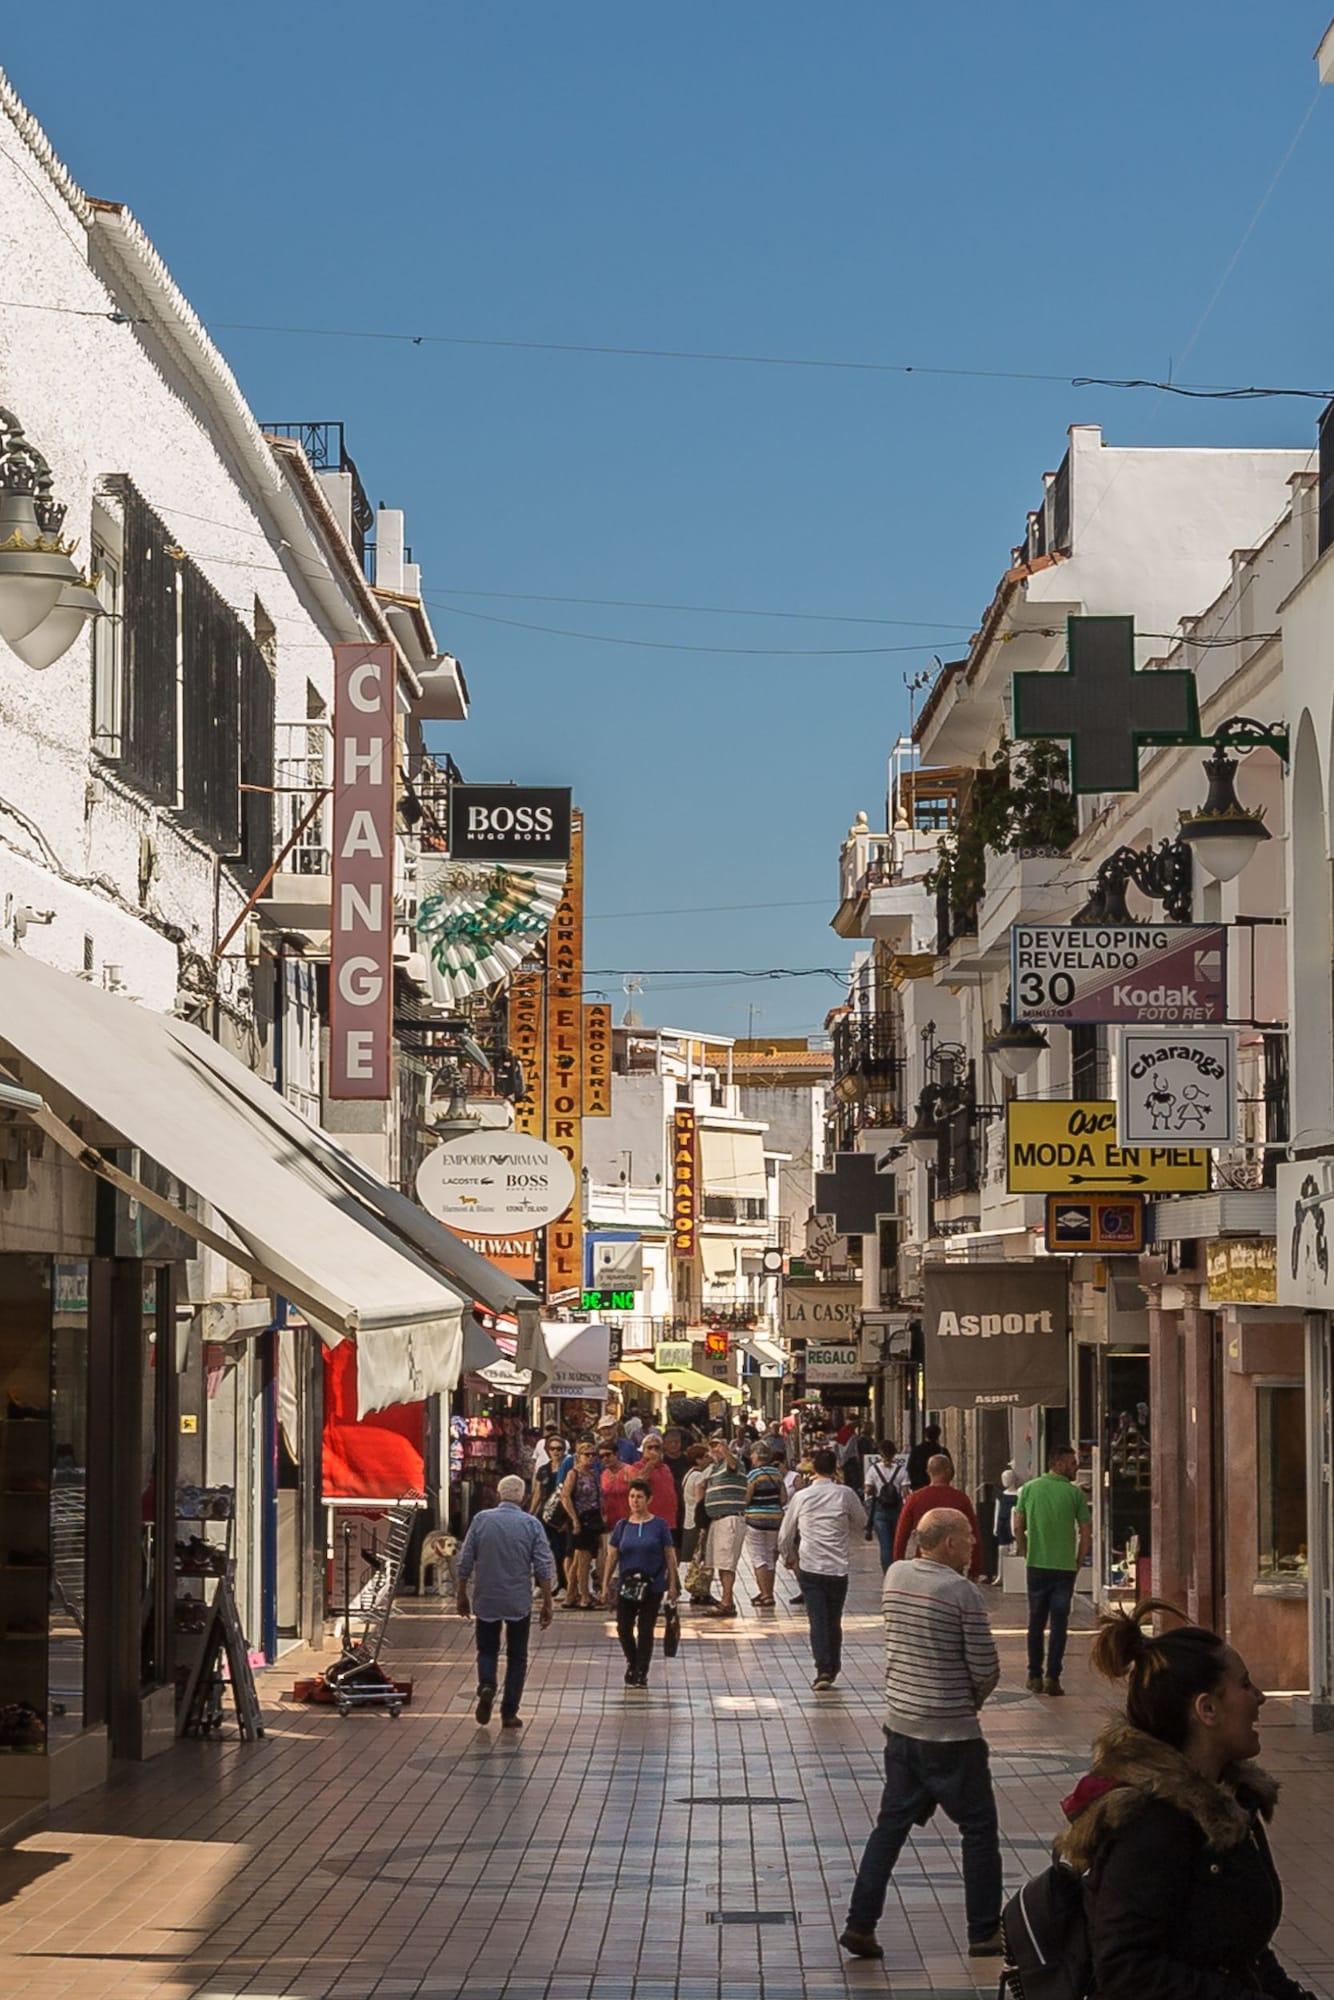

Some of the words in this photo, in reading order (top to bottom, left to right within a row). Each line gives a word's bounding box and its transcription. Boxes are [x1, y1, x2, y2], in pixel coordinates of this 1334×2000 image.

[468, 806, 553, 832] BOSS
[467, 833, 505, 841] HUGO
[514, 833, 552, 841] BOSS
[338, 663, 384, 1079] CHANGE
[1018, 931, 1168, 950] DEVELOPING
[1018, 952, 1138, 969] REVELADO
[1019, 972, 1076, 1007] 30
[1112, 985, 1198, 1007] Kodak
[1022, 1009, 1074, 1018] MINUTOS
[1137, 1008, 1178, 1020] FOTO
[1182, 1006, 1215, 1020] REY
[556, 1010, 574, 1051] EL
[589, 1007, 605, 1112] ARROCERIA
[1129, 1046, 1226, 1081] Charanga
[443, 1154, 492, 1166] EMPORIO
[506, 1154, 548, 1166] ARMANI
[1014, 1143, 1095, 1167] MODA
[1105, 1143, 1141, 1167] EN
[1150, 1147, 1203, 1167] PIEL
[442, 1177, 479, 1185] LACOSTE
[506, 1175, 549, 1187] BOSS
[674, 1132, 693, 1249] TABACOS
[786, 1303, 806, 1321] LA
[937, 1309, 1053, 1338] Asport
[808, 1350, 857, 1366] REGALO
[975, 1393, 1020, 1403] Asport
